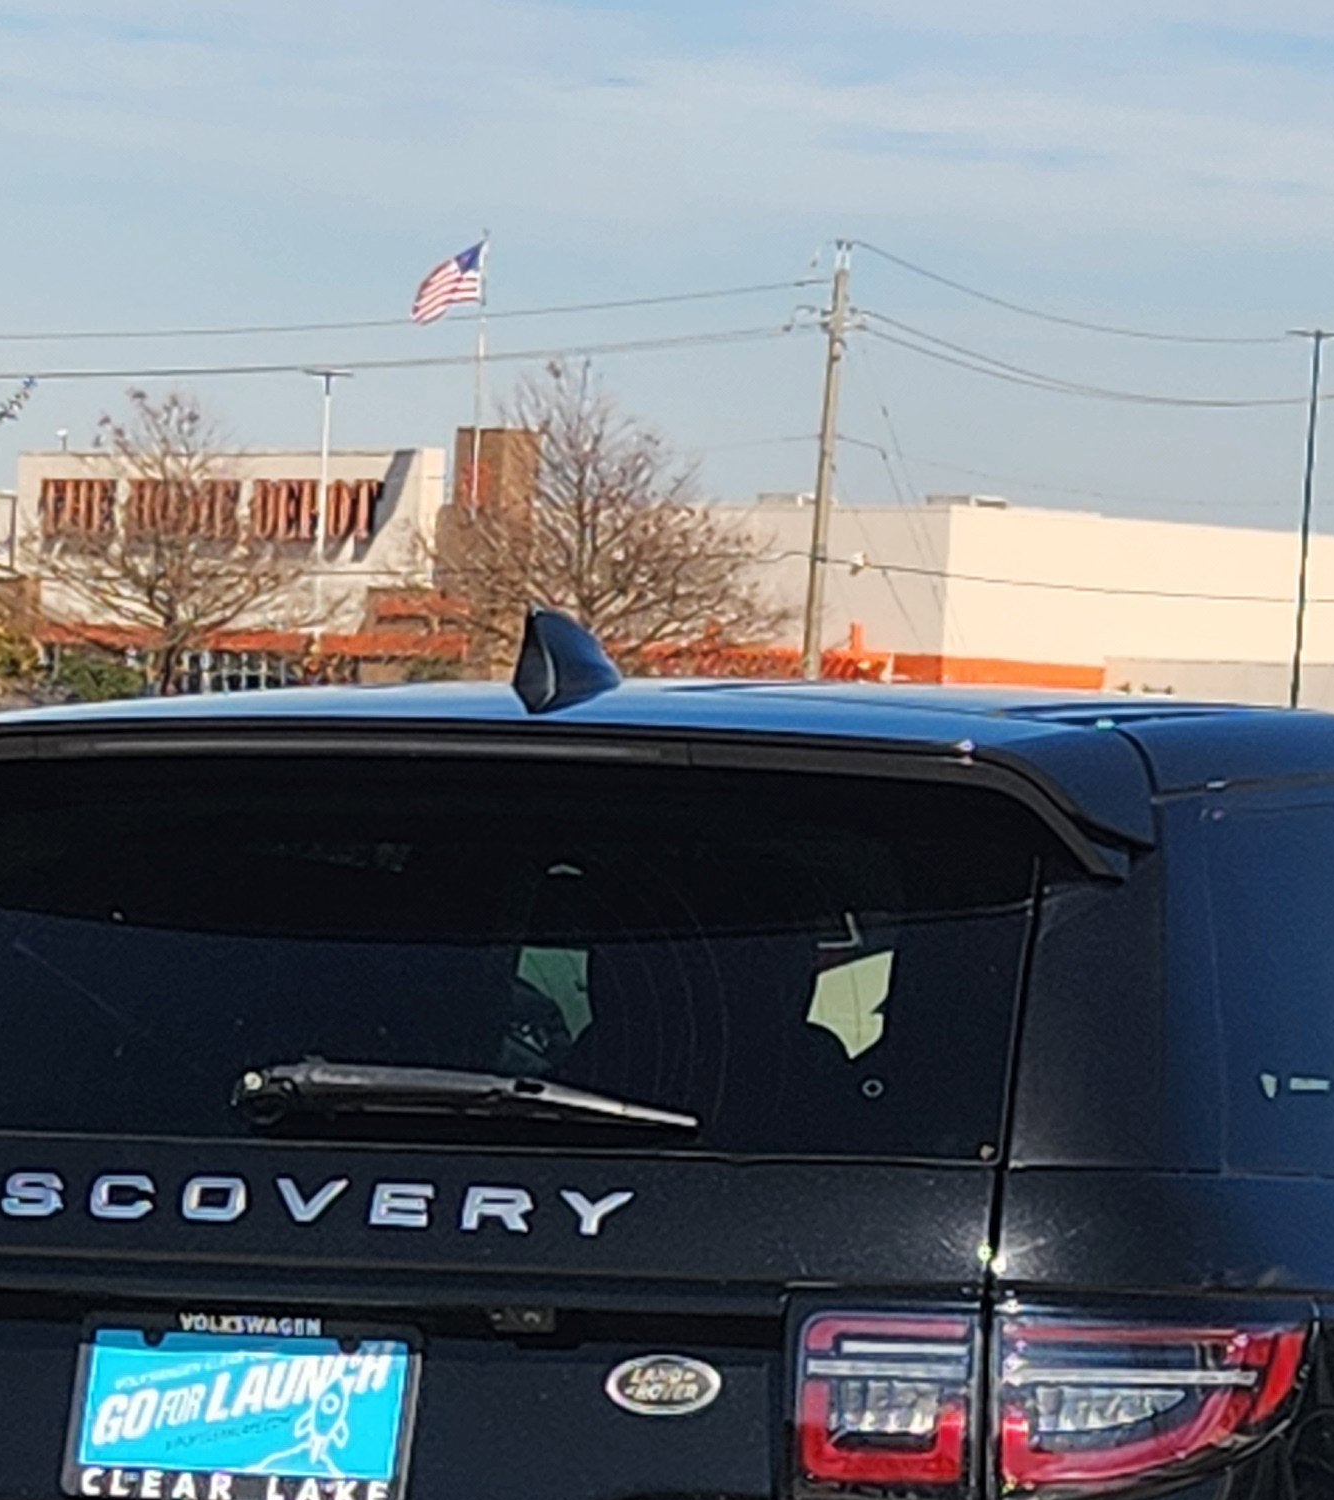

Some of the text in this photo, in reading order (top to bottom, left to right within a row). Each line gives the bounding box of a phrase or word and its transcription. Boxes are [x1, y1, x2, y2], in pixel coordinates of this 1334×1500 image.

[179, 1312, 322, 1336] VOLKSWAGEN
[91, 1387, 159, 1446] GO
[154, 1382, 208, 1429] FOR
[204, 1340, 397, 1422] LAUNCH
